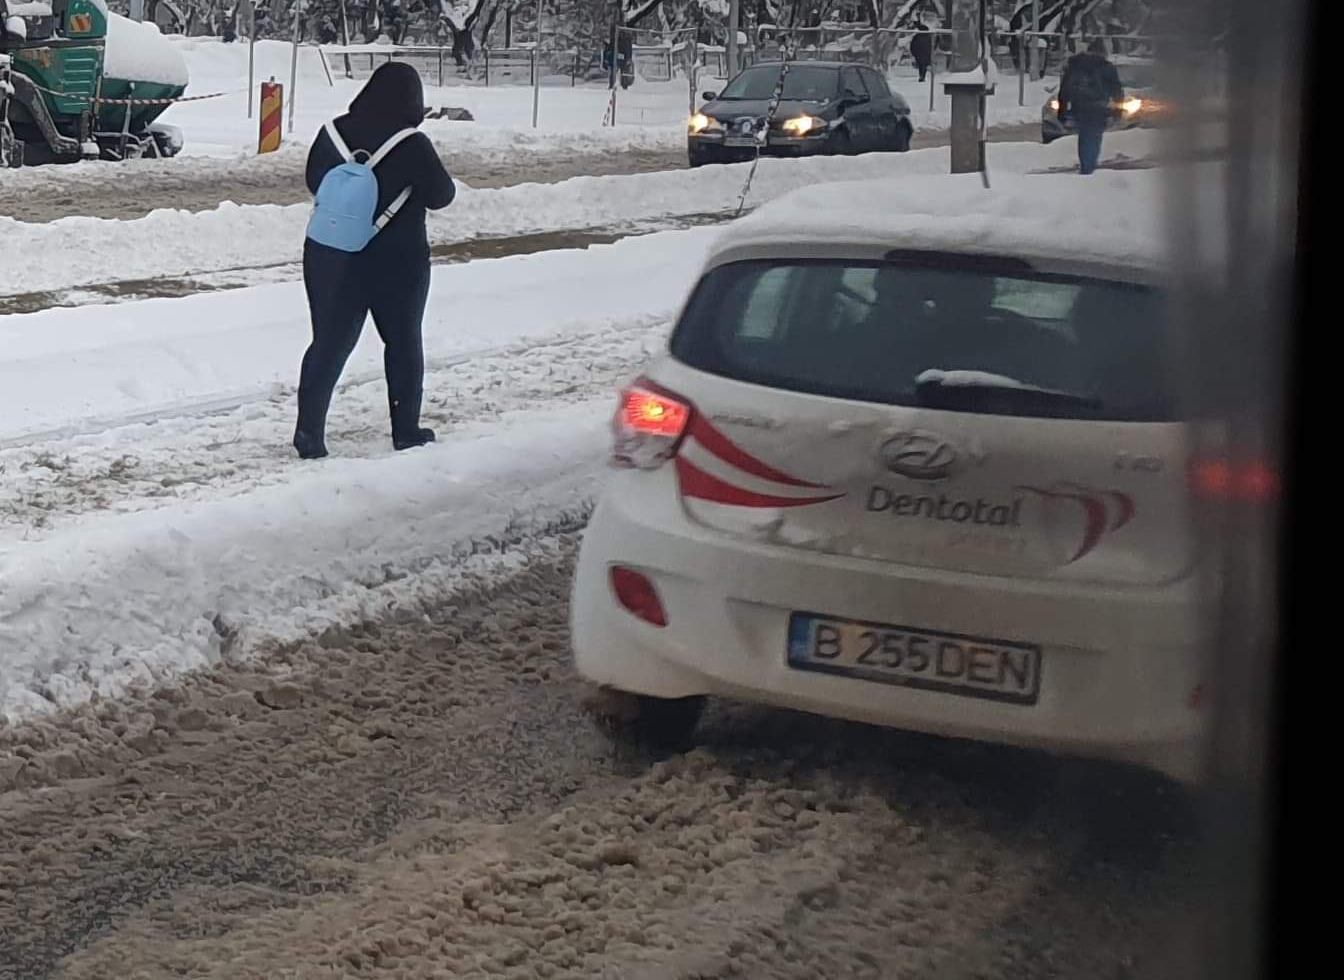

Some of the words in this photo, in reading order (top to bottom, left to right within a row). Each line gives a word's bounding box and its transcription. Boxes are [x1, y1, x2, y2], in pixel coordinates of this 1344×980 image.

[865, 485, 1024, 527] Dentotal
[813, 622, 843, 659] B
[855, 631, 930, 673] 255
[934, 641, 1030, 690] DEN
